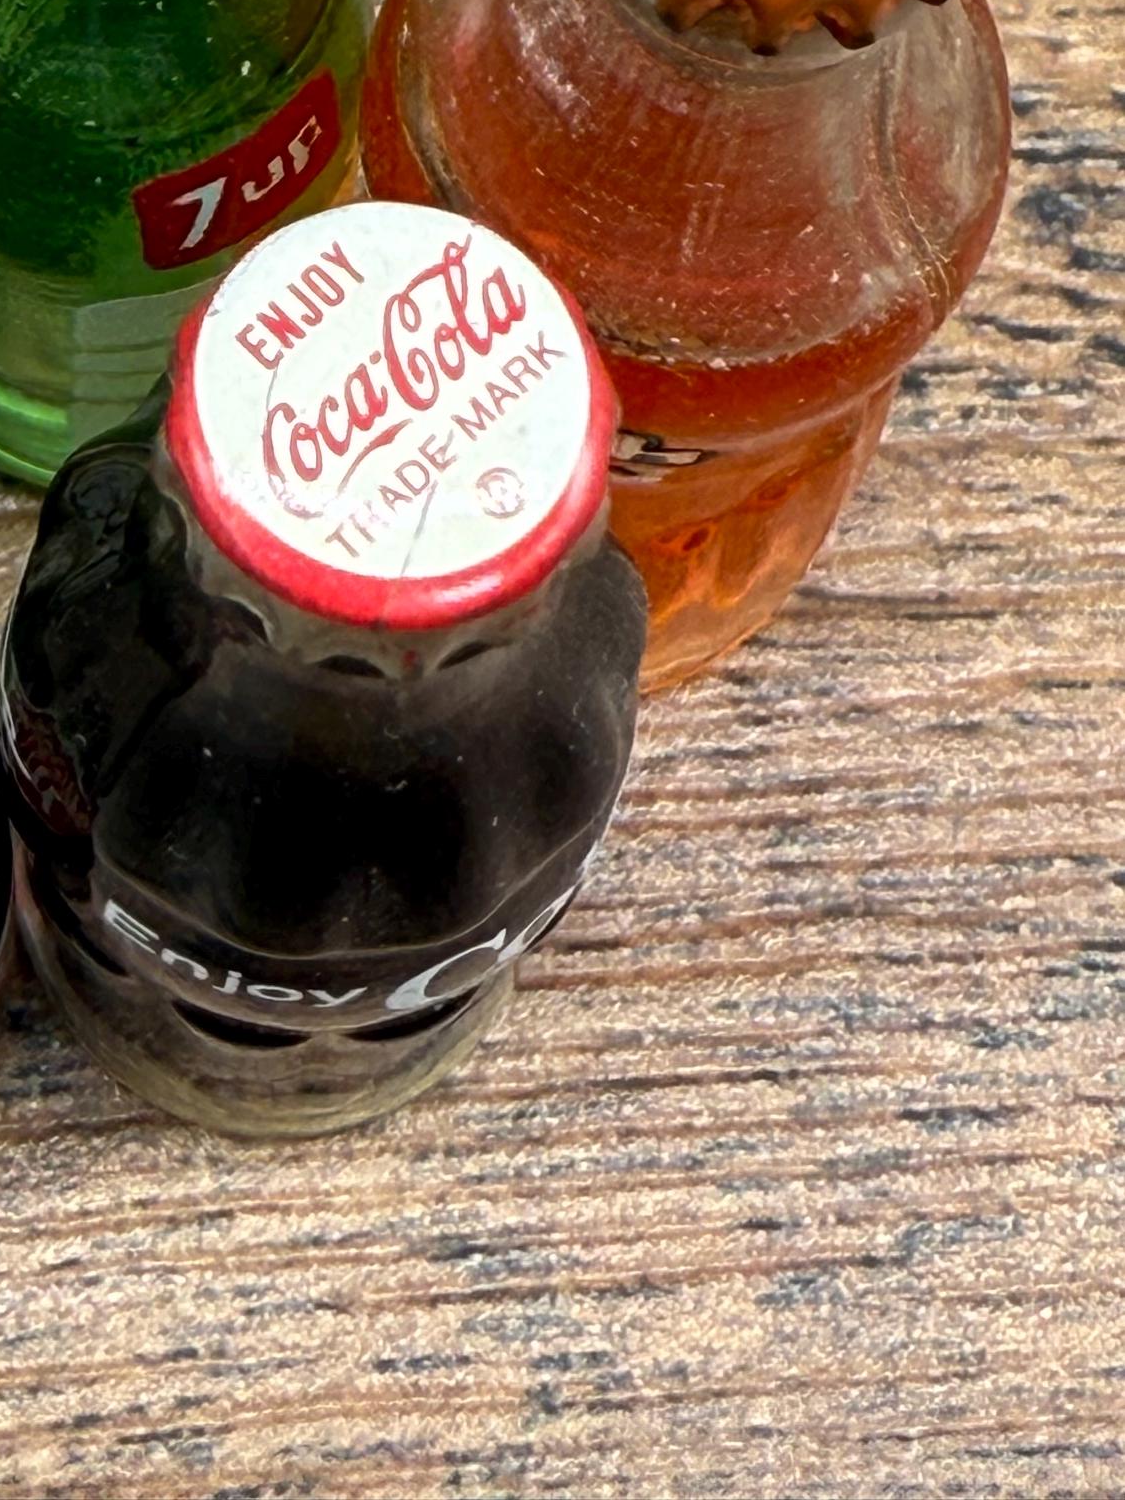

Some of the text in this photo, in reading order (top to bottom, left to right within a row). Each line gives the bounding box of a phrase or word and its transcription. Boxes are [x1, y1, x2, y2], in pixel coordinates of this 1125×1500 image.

[235, 241, 365, 370] ENJOY
[261, 233, 527, 518] Coca-Cola
[451, 330, 568, 440] MARK
[102, 899, 369, 1009] Enjoy
